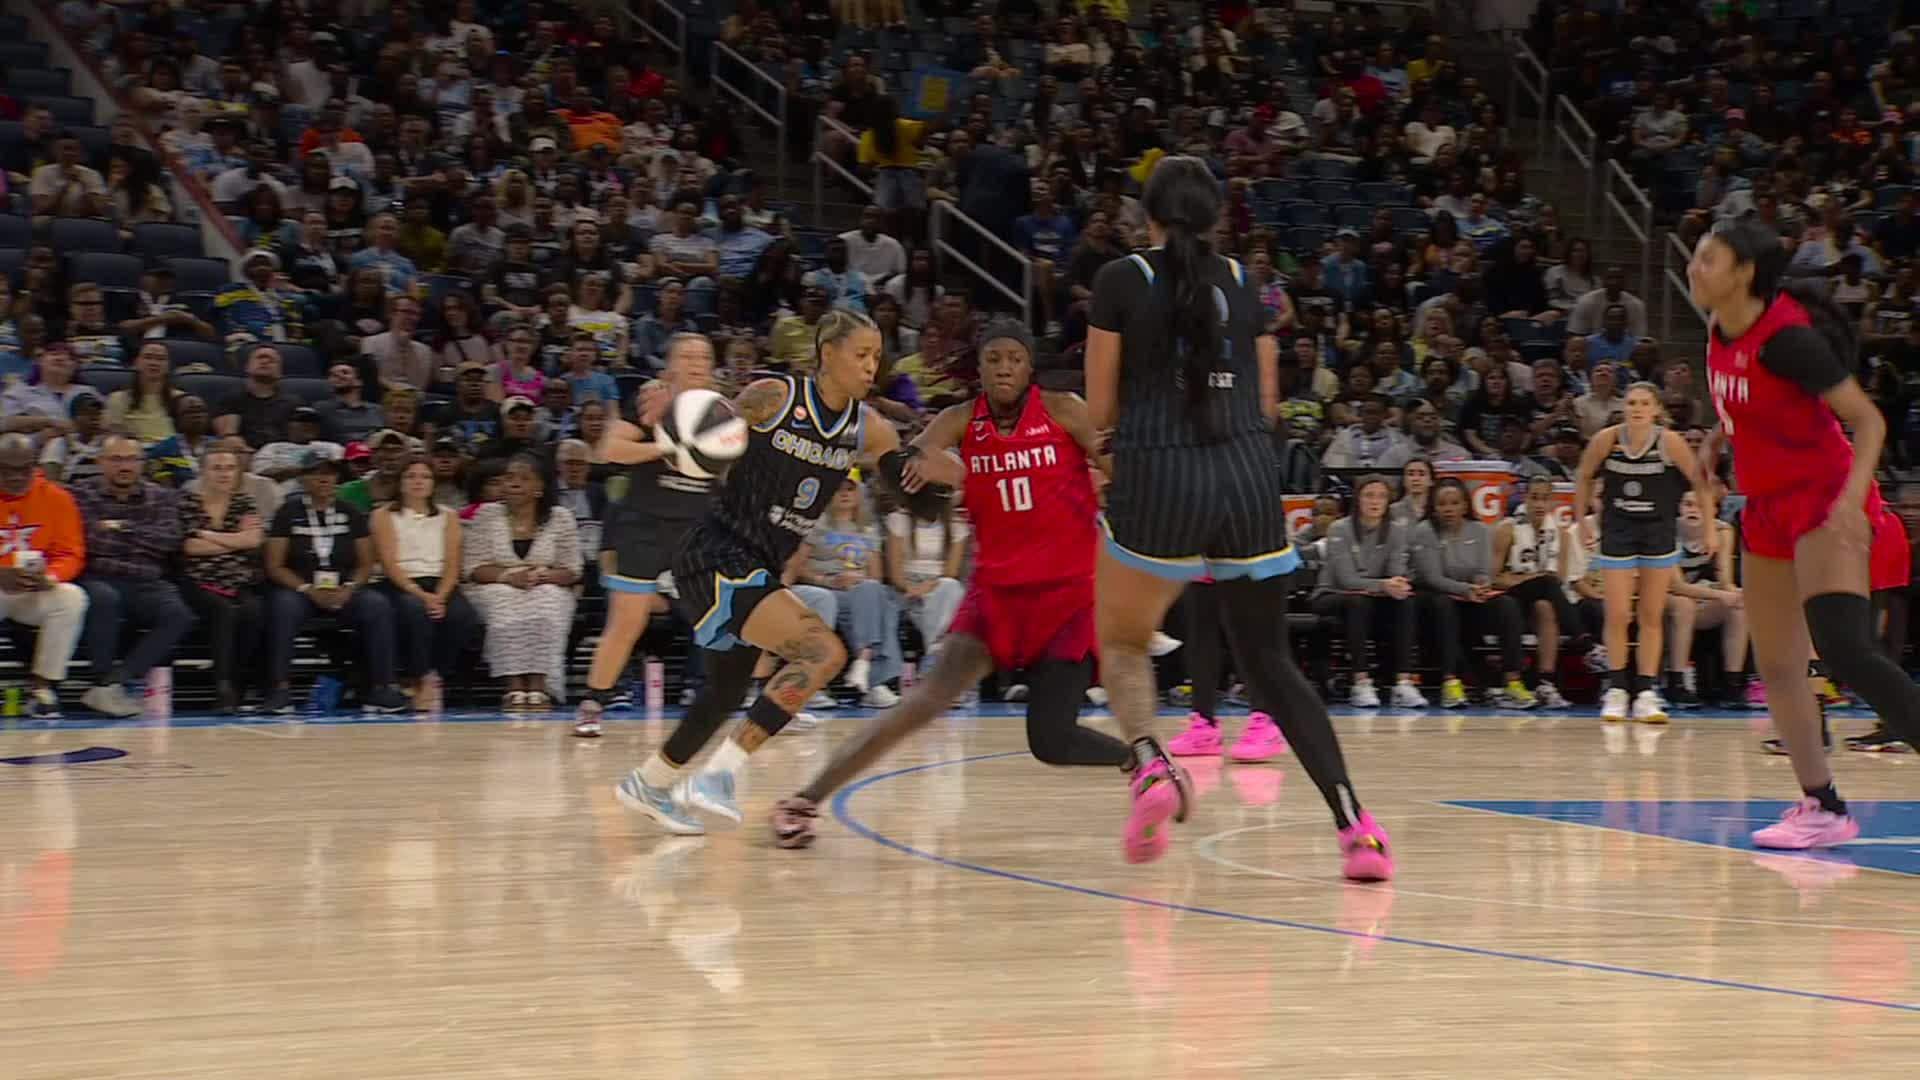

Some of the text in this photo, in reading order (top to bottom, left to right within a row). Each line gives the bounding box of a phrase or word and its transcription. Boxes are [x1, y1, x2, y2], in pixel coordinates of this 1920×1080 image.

[970, 445, 1057, 473] ATLANTA
[793, 477, 821, 510] 9
[995, 476, 1033, 512] 10
[1471, 485, 1506, 519] G
